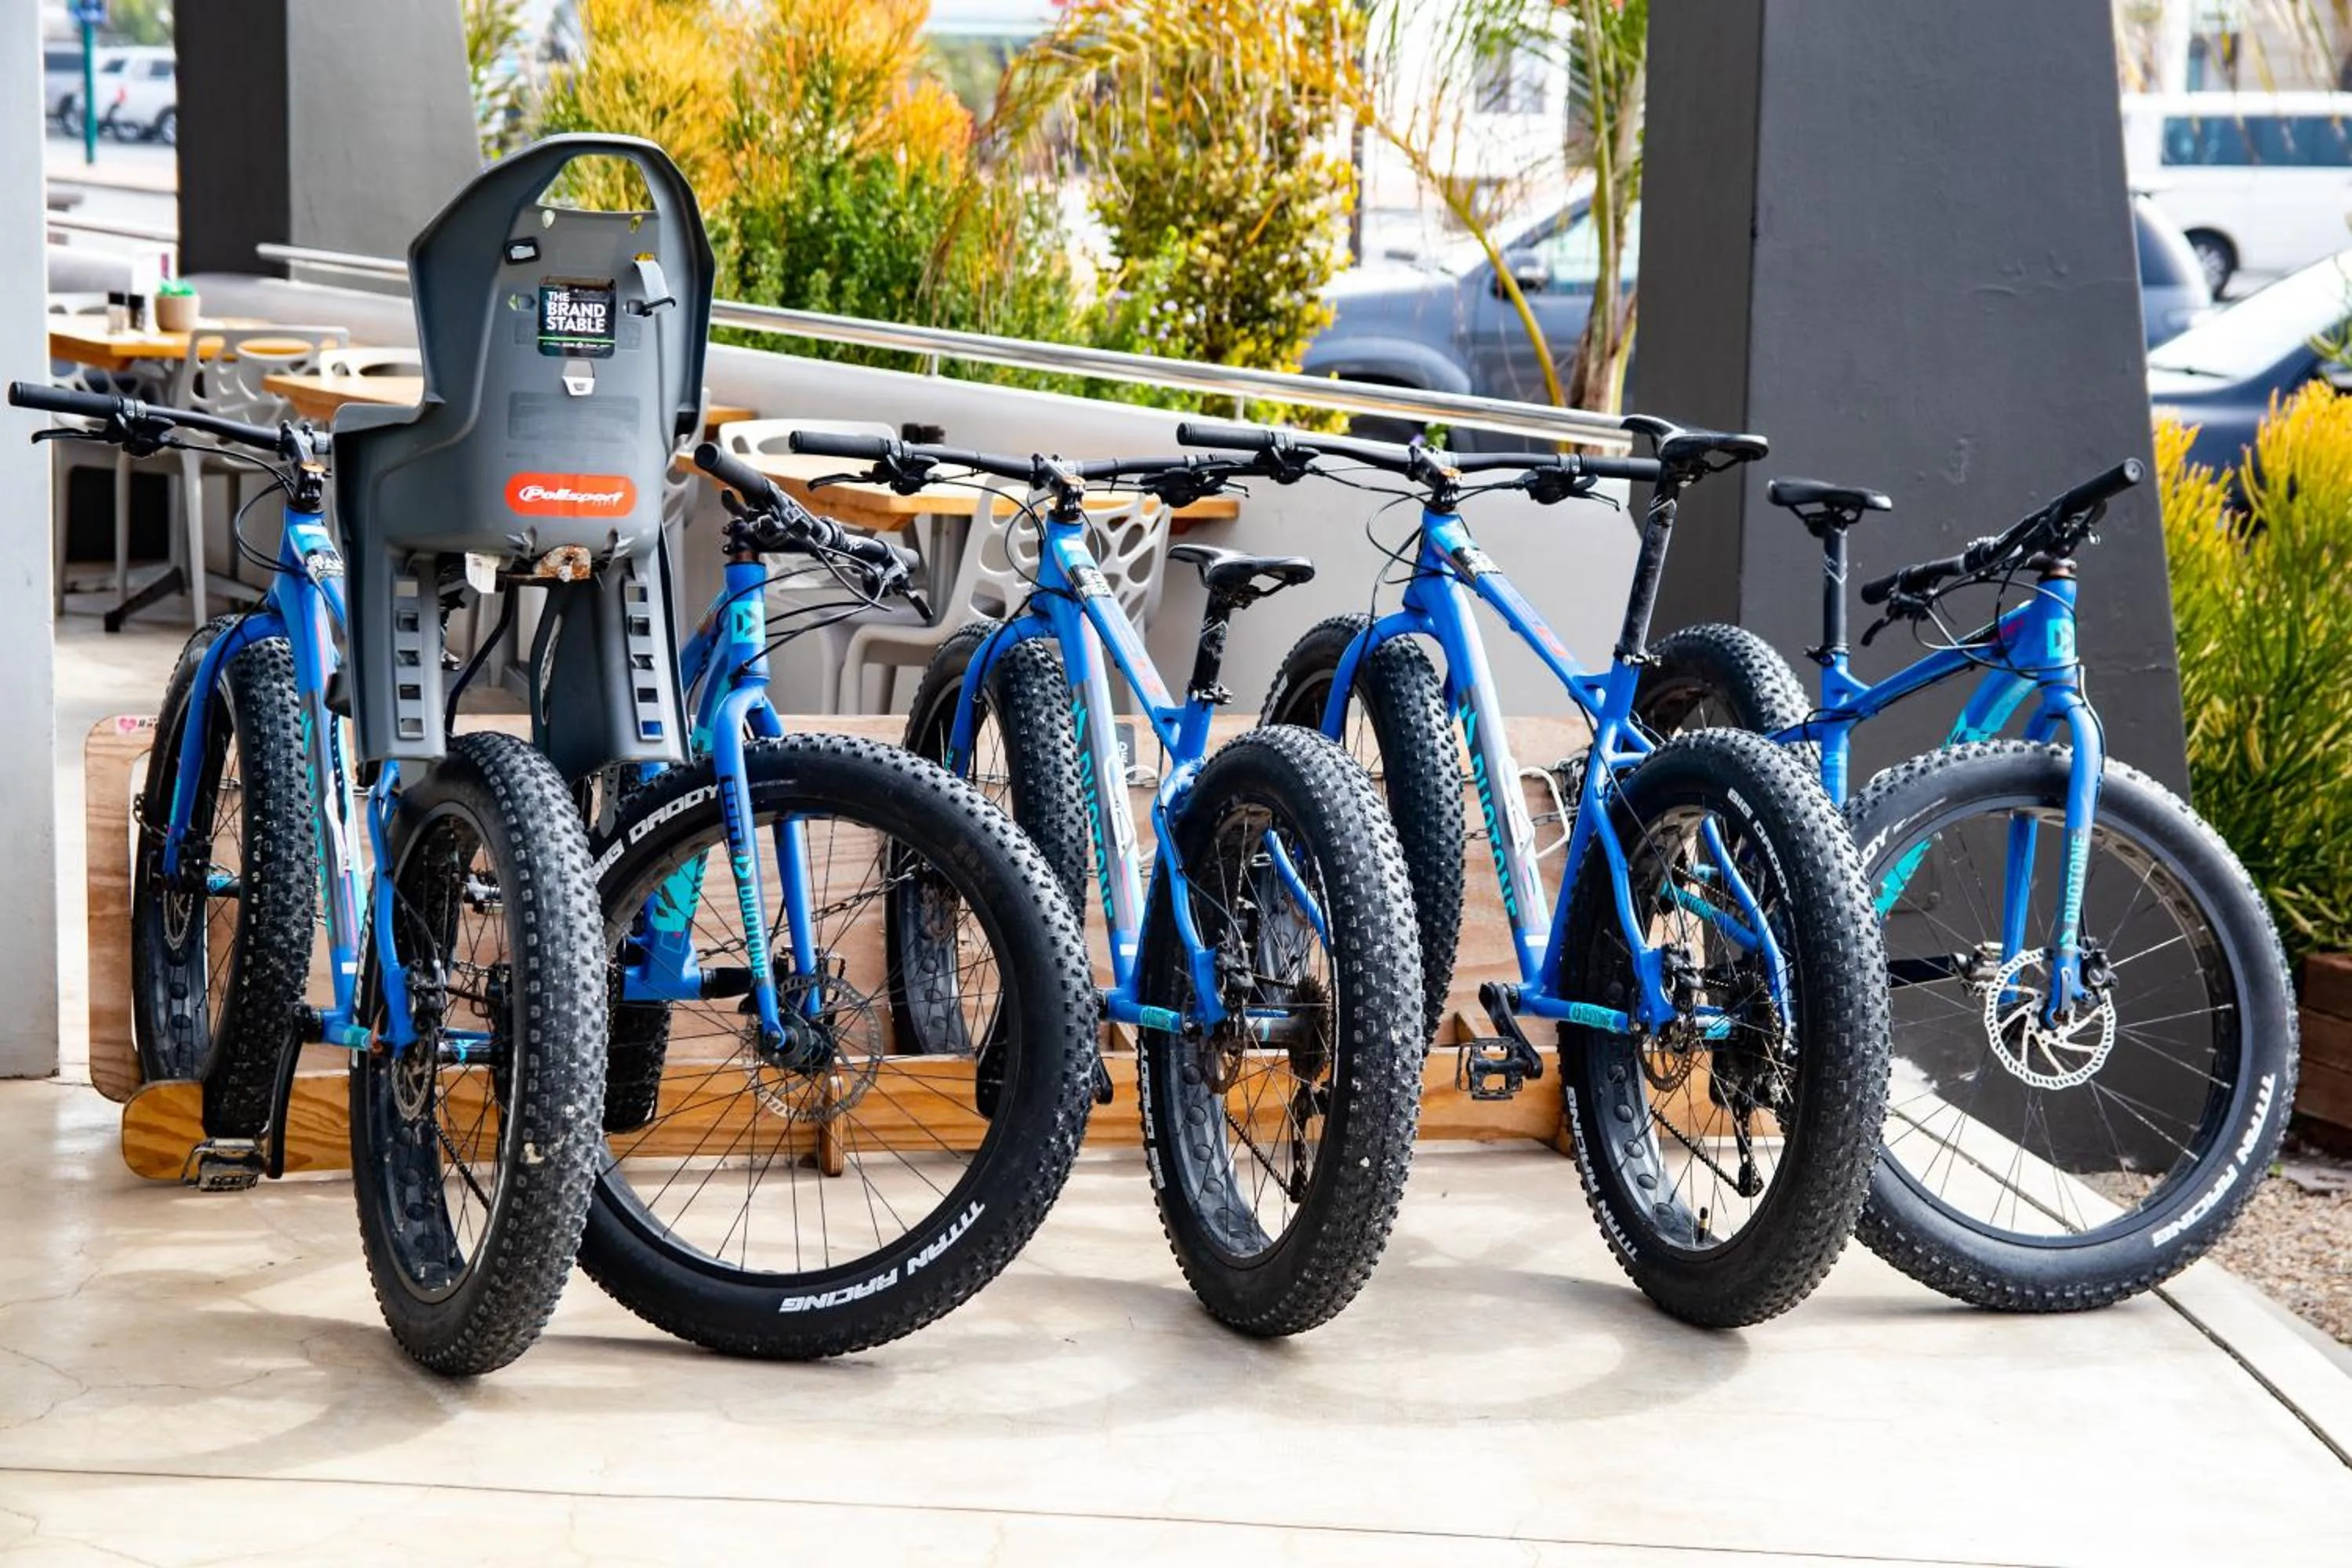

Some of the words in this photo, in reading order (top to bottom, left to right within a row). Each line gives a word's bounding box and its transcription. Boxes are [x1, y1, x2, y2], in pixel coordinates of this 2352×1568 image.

[546, 291, 570, 302] THE
[546, 302, 606, 318] BRAND
[546, 316, 606, 333] STABLE
[518, 485, 624, 503] Polisport
[628, 784, 719, 845] DADDY
[1727, 787, 1754, 819] BIG
[1752, 820, 1793, 906] DADDY
[2063, 834, 2089, 924] DUOTONE
[739, 884, 768, 980] DUOTONE
[1140, 1039, 1155, 1139] DADDY
[2235, 1073, 2277, 1166] TITAN
[1566, 1085, 1600, 1193] RACING
[906, 1200, 985, 1276] TITAN
[1597, 1199, 1639, 1262] TITAN
[2151, 1163, 2239, 1248] RACING
[778, 1267, 898, 1313] RACING
